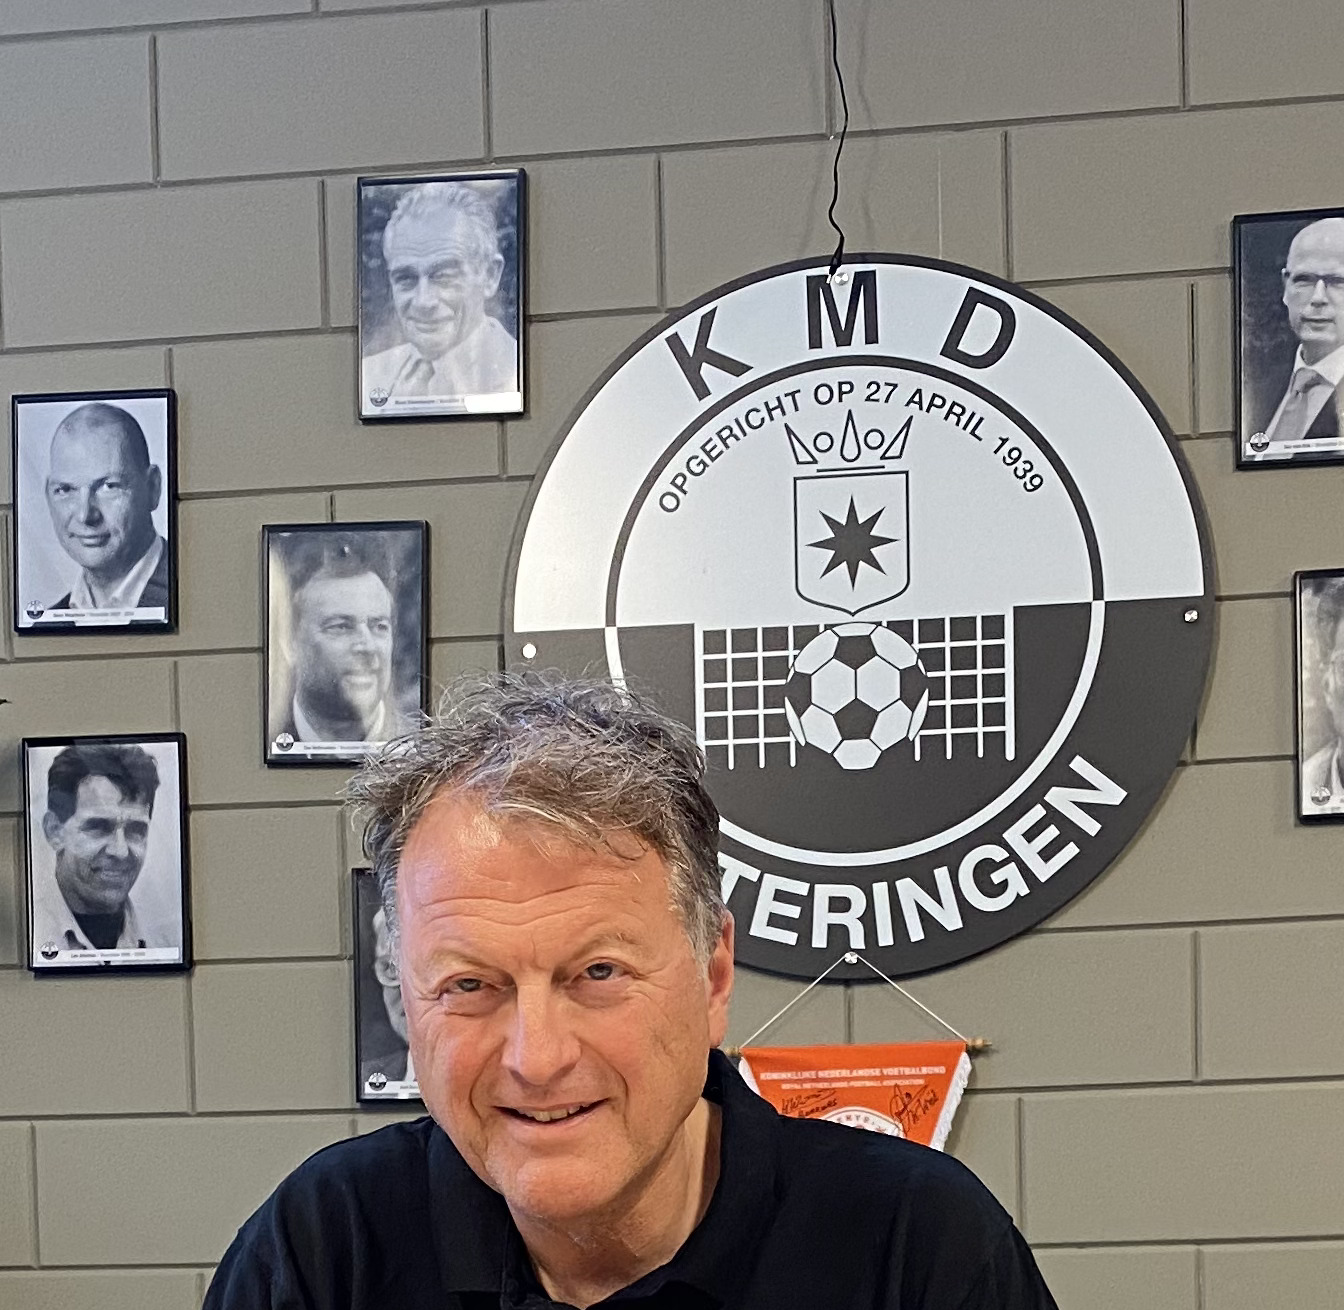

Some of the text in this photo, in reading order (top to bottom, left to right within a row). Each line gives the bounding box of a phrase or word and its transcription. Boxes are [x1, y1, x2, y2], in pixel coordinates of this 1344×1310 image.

[658, 381, 1046, 515] OPGERICHT OP 27 APRIL 1939
[718, 755, 1128, 949] TERINGEN
